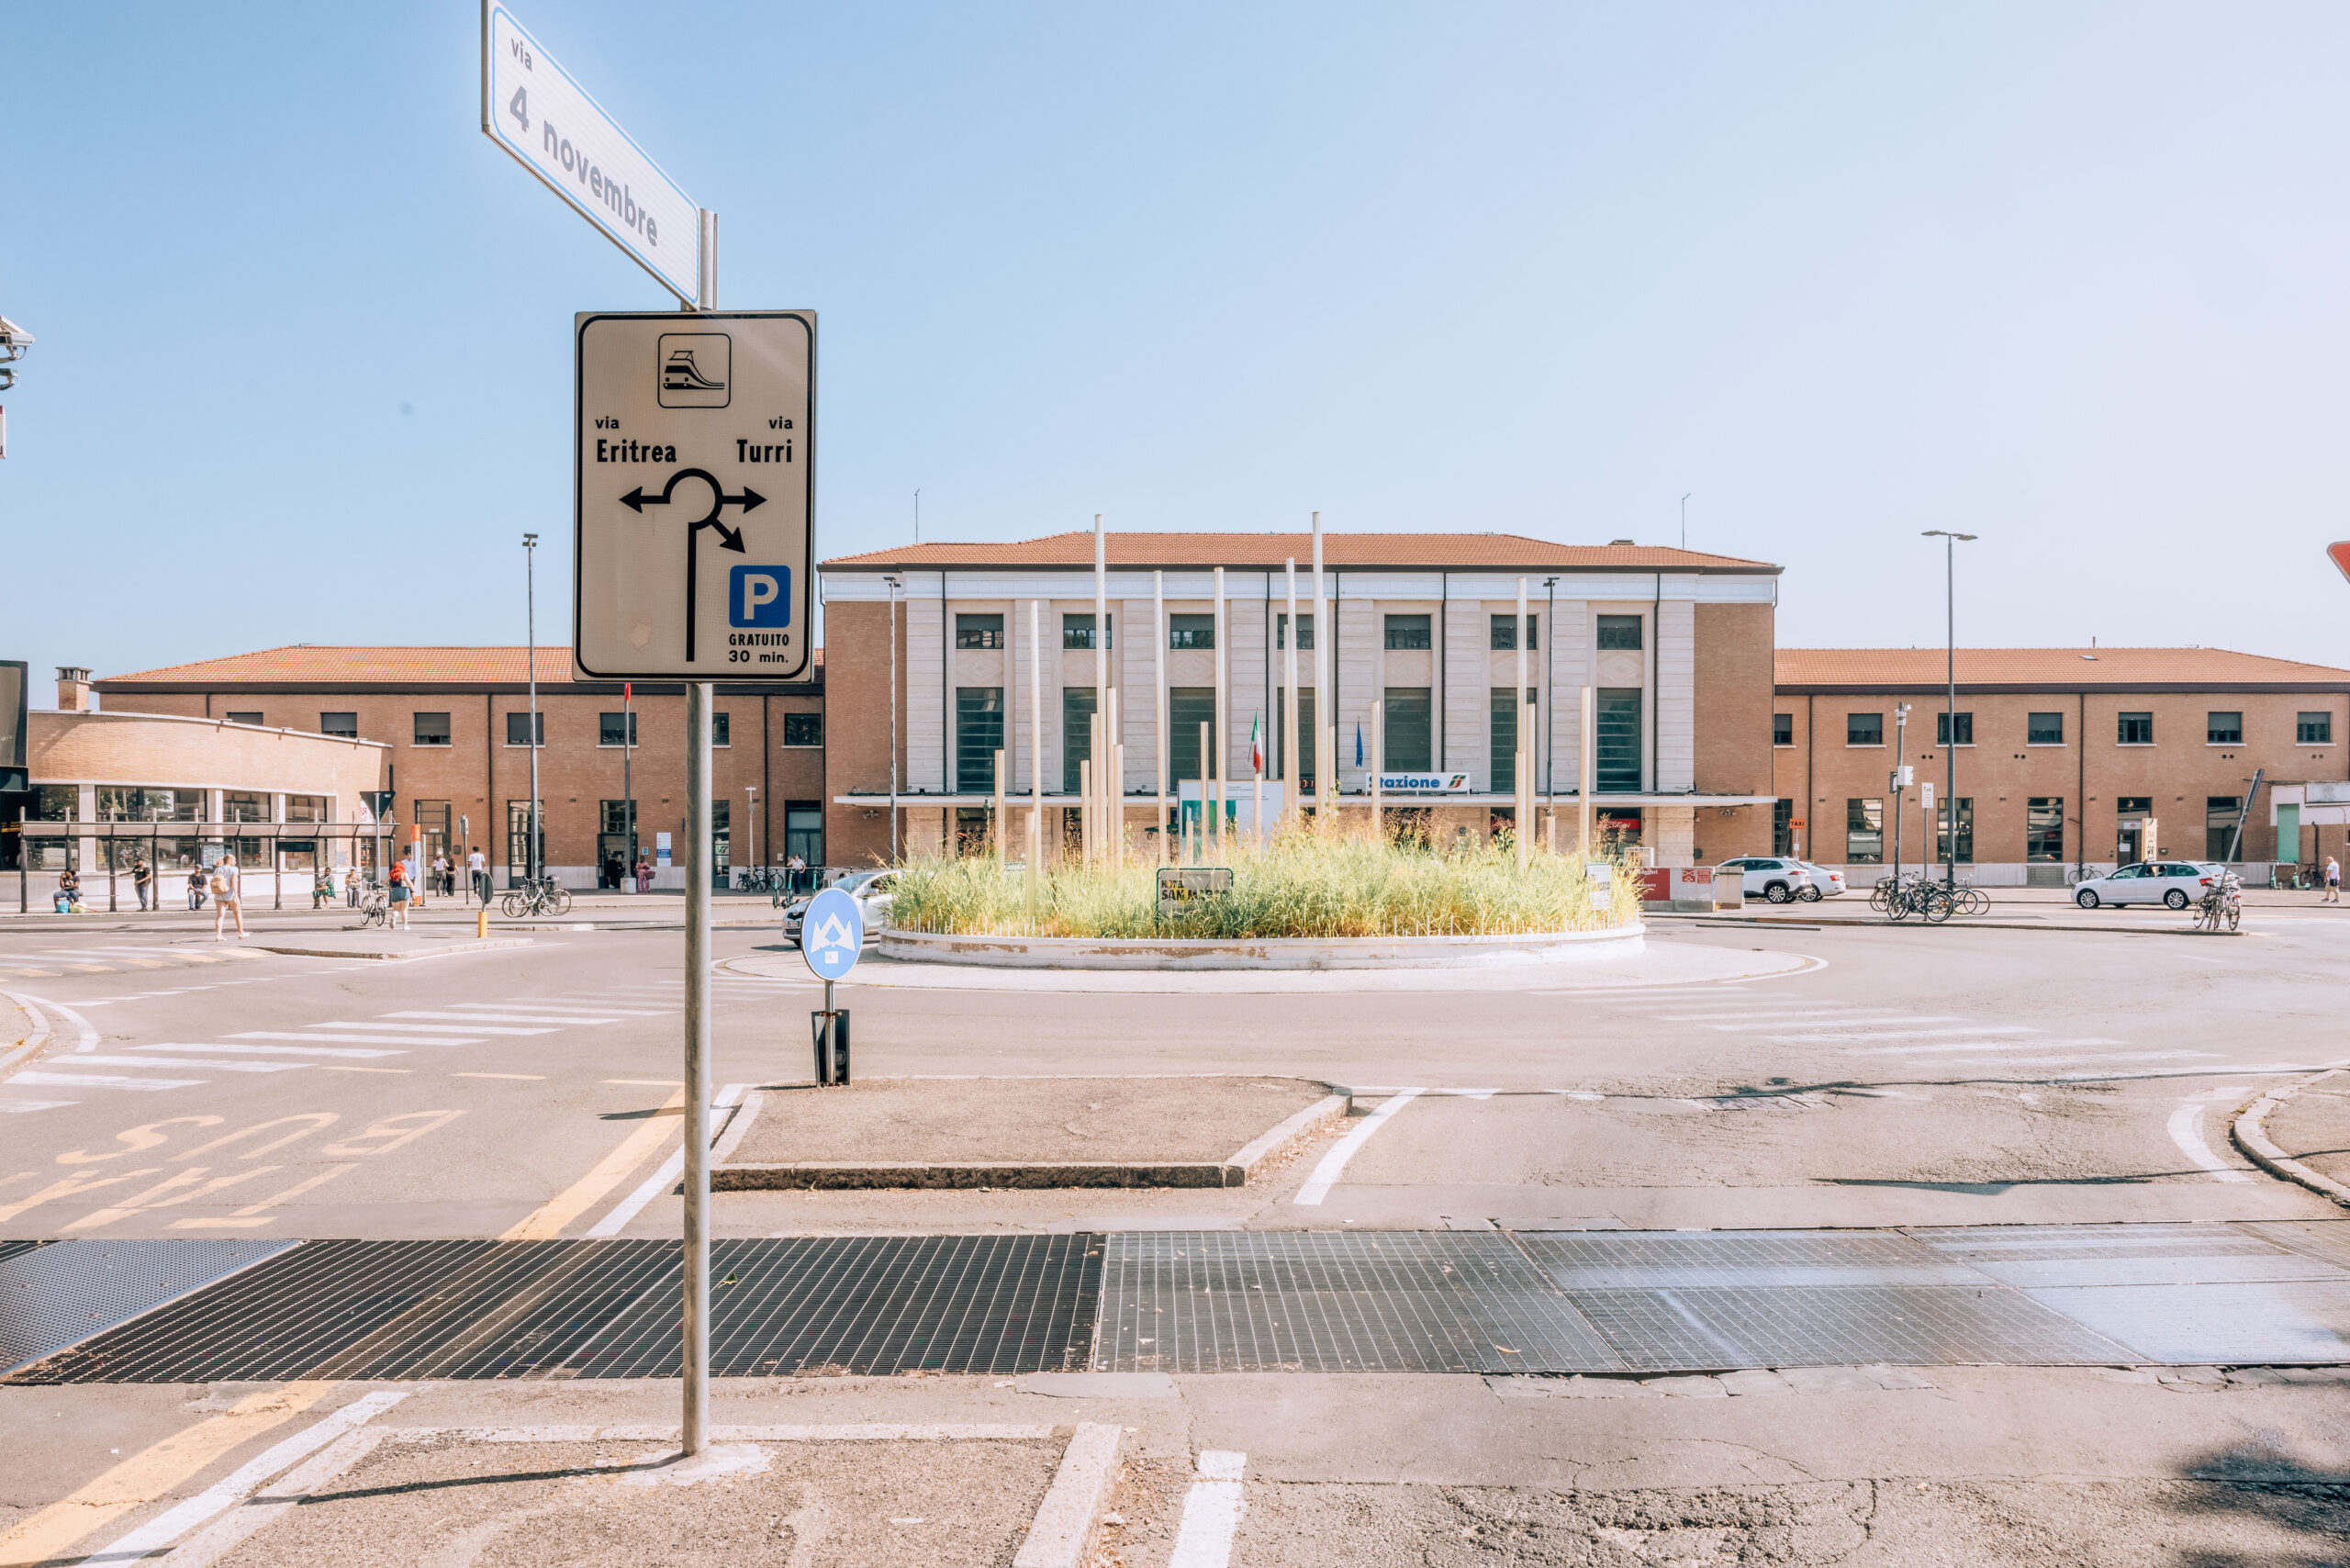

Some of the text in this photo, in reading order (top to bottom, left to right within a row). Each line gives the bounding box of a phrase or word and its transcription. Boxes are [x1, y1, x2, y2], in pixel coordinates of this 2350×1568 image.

[510, 38, 533, 72] via
[509, 85, 658, 247] 4 novembre
[595, 416, 620, 429] via
[769, 416, 793, 429] via
[597, 439, 677, 463] Eritrea
[737, 439, 792, 463] Turri
[744, 574, 778, 620] P
[729, 633, 789, 646] GRATUITO
[729, 650, 789, 663] 30 min.
[55, 1110, 464, 1164] BUS
